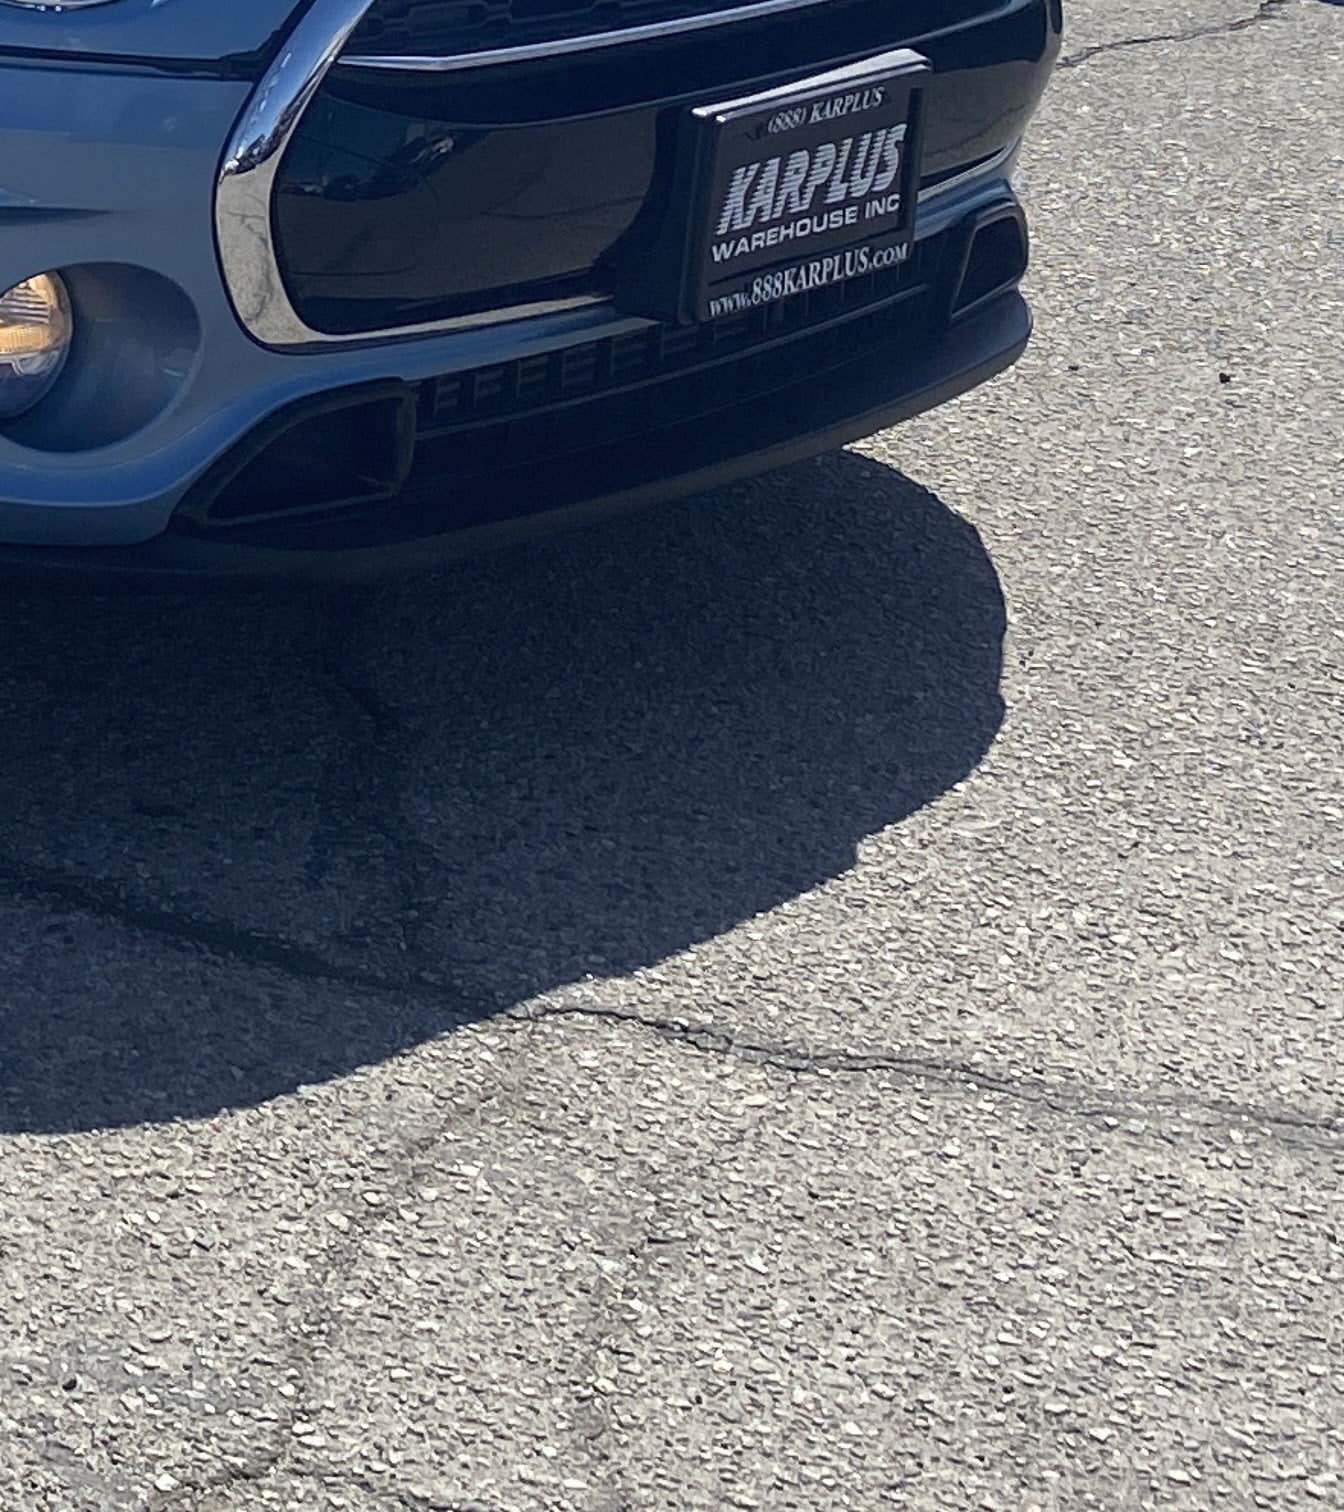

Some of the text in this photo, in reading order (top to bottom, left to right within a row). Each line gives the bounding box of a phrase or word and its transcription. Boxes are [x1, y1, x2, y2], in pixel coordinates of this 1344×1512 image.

[767, 86, 886, 135] (888) KARPLUS
[715, 123, 908, 236] KARPLUS
[712, 193, 901, 263] WAREHOUSE INC
